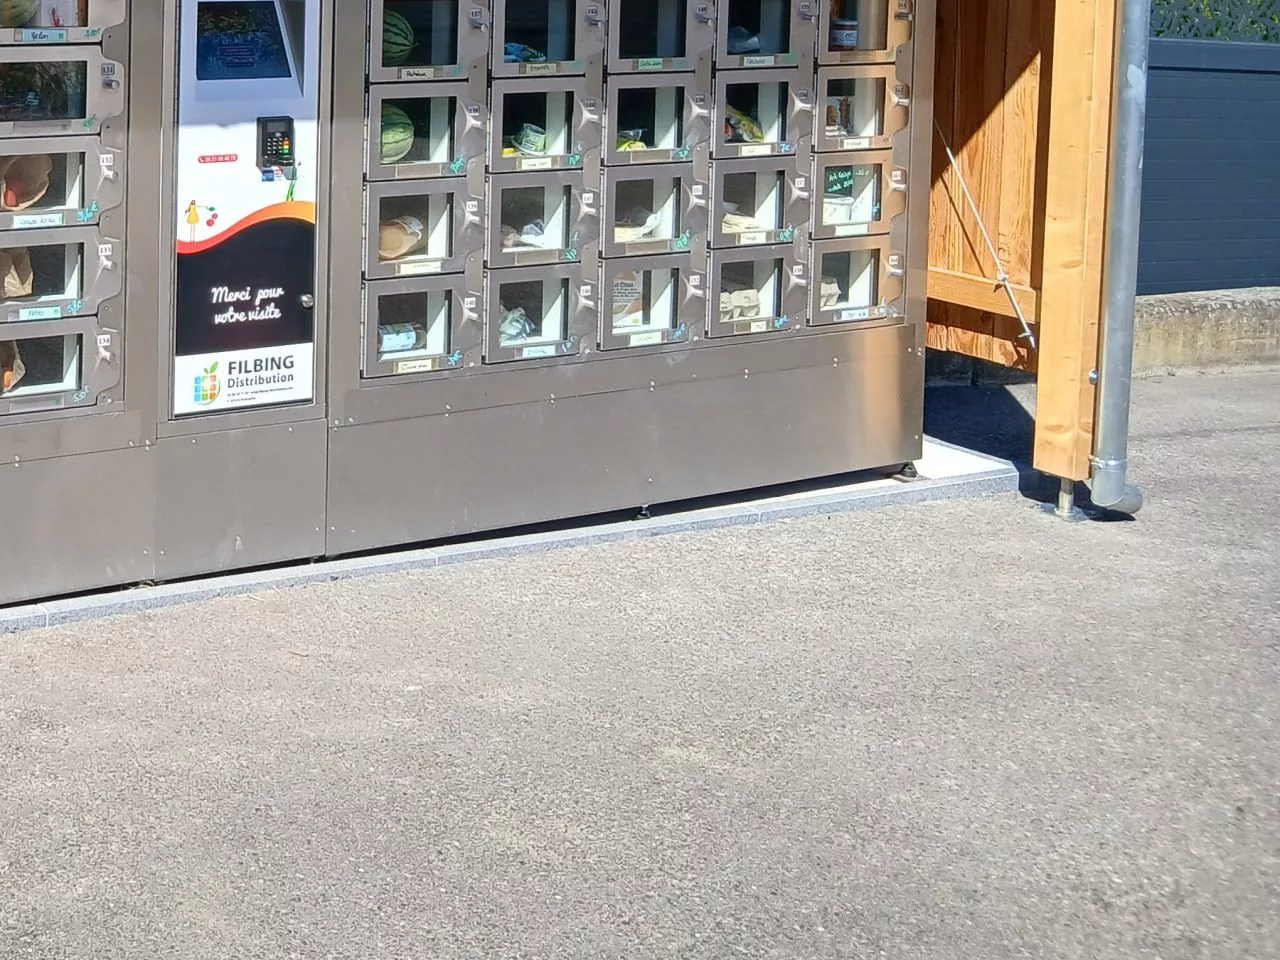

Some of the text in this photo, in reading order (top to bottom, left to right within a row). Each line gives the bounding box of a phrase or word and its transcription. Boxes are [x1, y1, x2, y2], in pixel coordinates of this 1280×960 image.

[101, 65, 115, 74] 131
[100, 156, 113, 165] 132
[211, 286, 285, 307] Merci pour
[214, 302, 282, 324] votre visite
[228, 354, 295, 376] FILBING
[227, 372, 295, 389] Distribution
